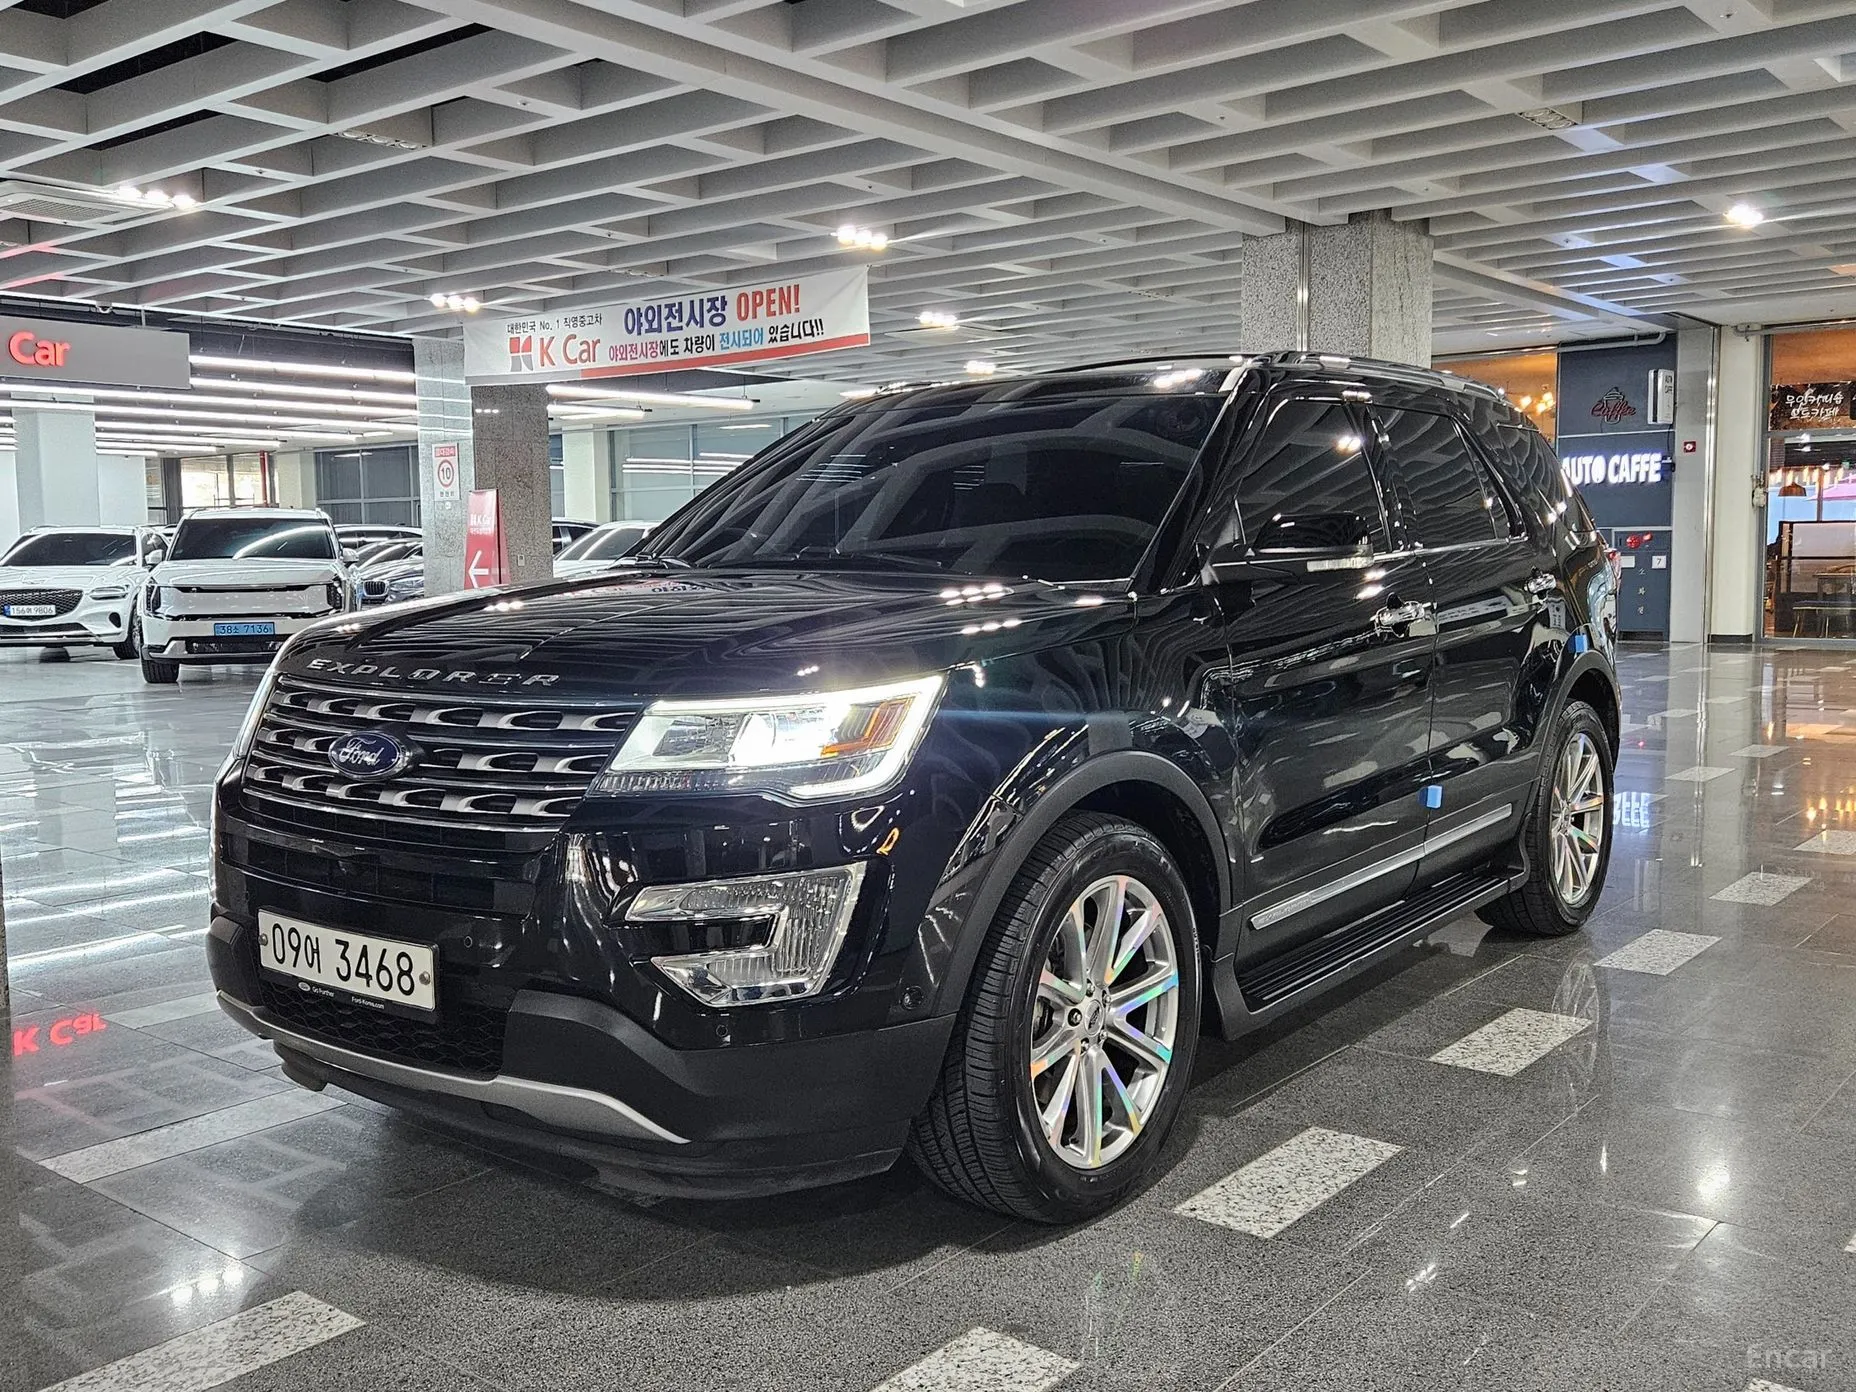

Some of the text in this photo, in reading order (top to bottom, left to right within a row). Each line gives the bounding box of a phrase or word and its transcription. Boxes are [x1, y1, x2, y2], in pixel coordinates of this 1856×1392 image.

[507, 321, 536, 334] 대한민국
[540, 320, 553, 331] No.
[563, 313, 602, 329] 직영중고차
[624, 284, 800, 336] 야외전시장 OPEN!
[9, 330, 71, 368] Car
[540, 334, 600, 367] K Car
[609, 318, 825, 362] 야외전시장에도 차량이 전시되어 있습니다!!
[1591, 400, 1637, 420] Coffee
[440, 466, 451, 480] 10
[1561, 452, 1662, 486] AUTO CAFFE
[244, 624, 269, 634] 7136
[307, 658, 560, 687] EXPLORER
[339, 736, 384, 767] Ford
[272, 923, 415, 996] 09어 3468
